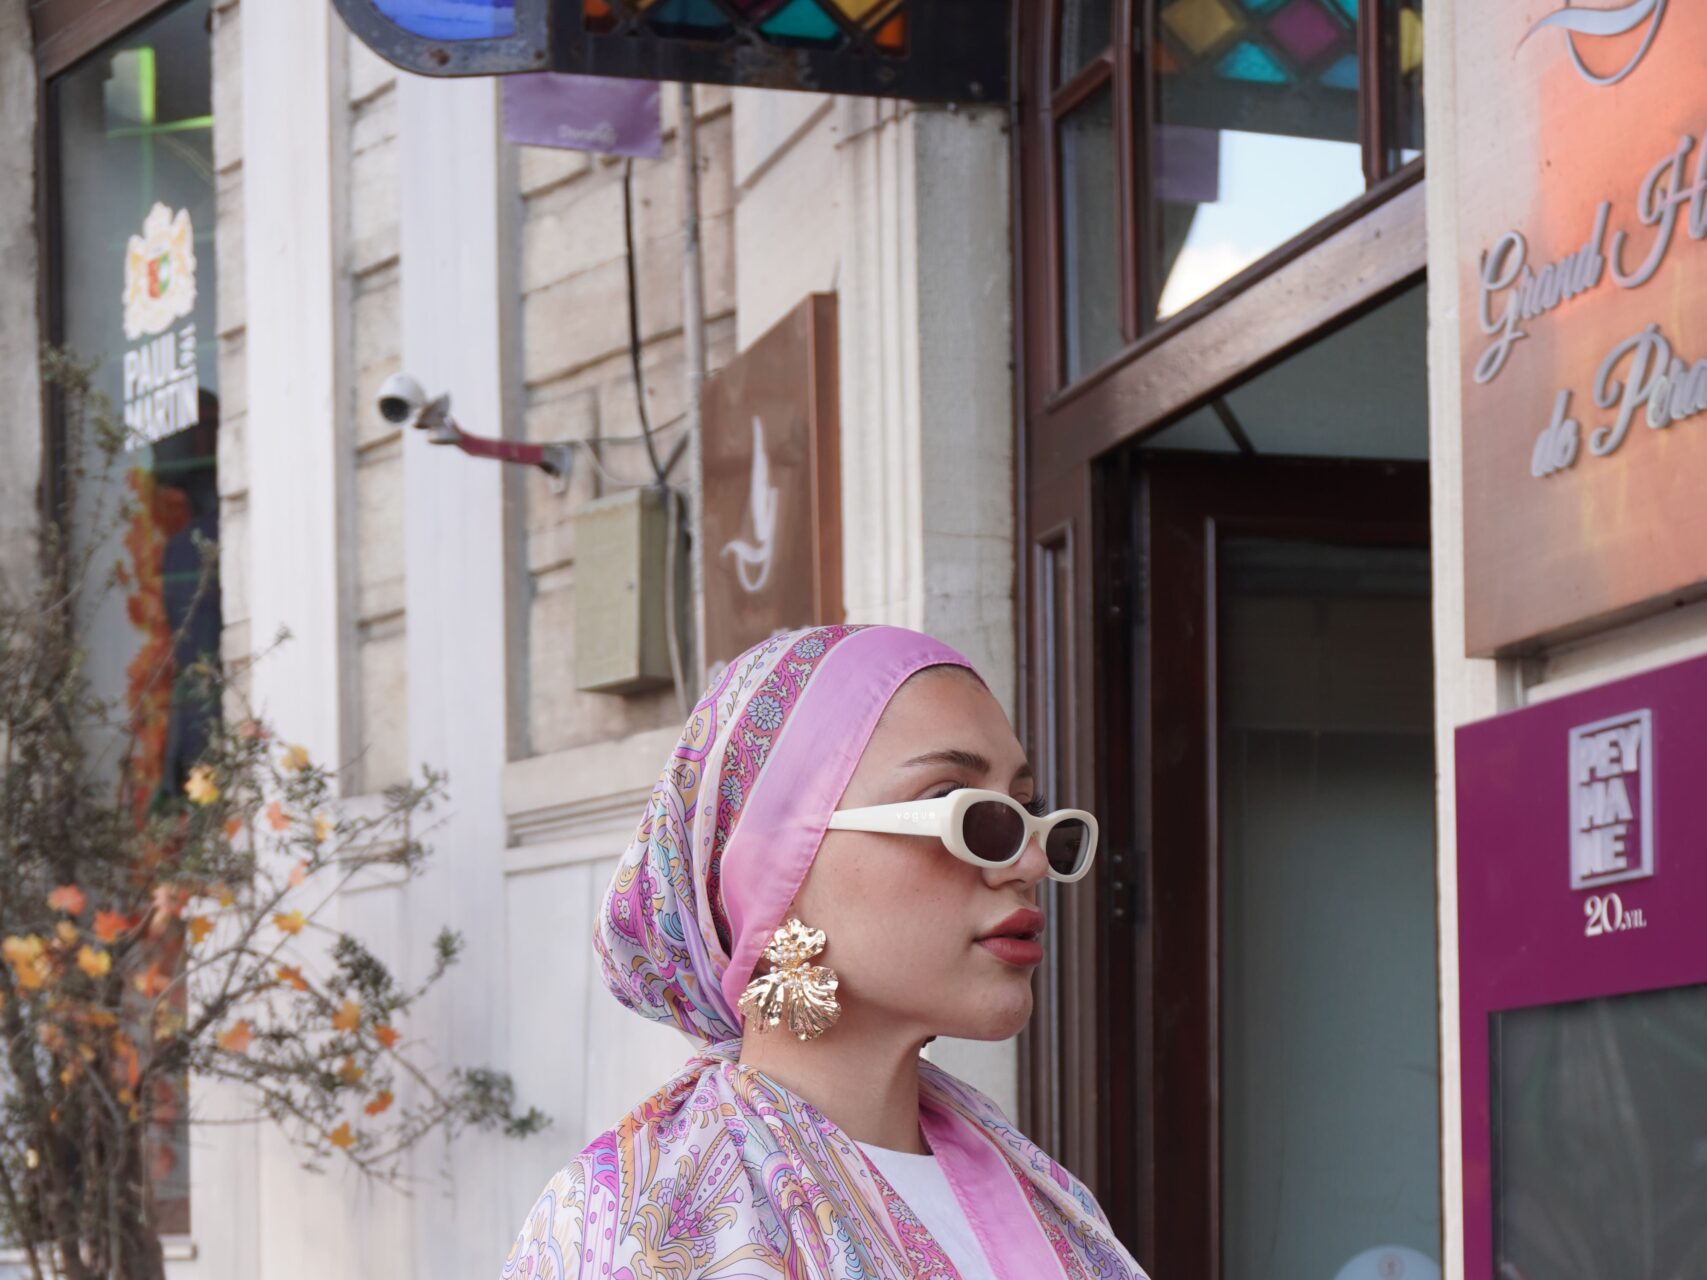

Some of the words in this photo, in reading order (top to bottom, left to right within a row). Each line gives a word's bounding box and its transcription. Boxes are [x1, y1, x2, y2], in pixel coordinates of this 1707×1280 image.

[1475, 200, 1609, 383] Grand
[124, 331, 181, 402] PAUL
[124, 377, 199, 453] MARTIN
[1579, 722, 1641, 784] PEY
[1579, 776, 1633, 831] MA
[1579, 824, 1628, 879] NE
